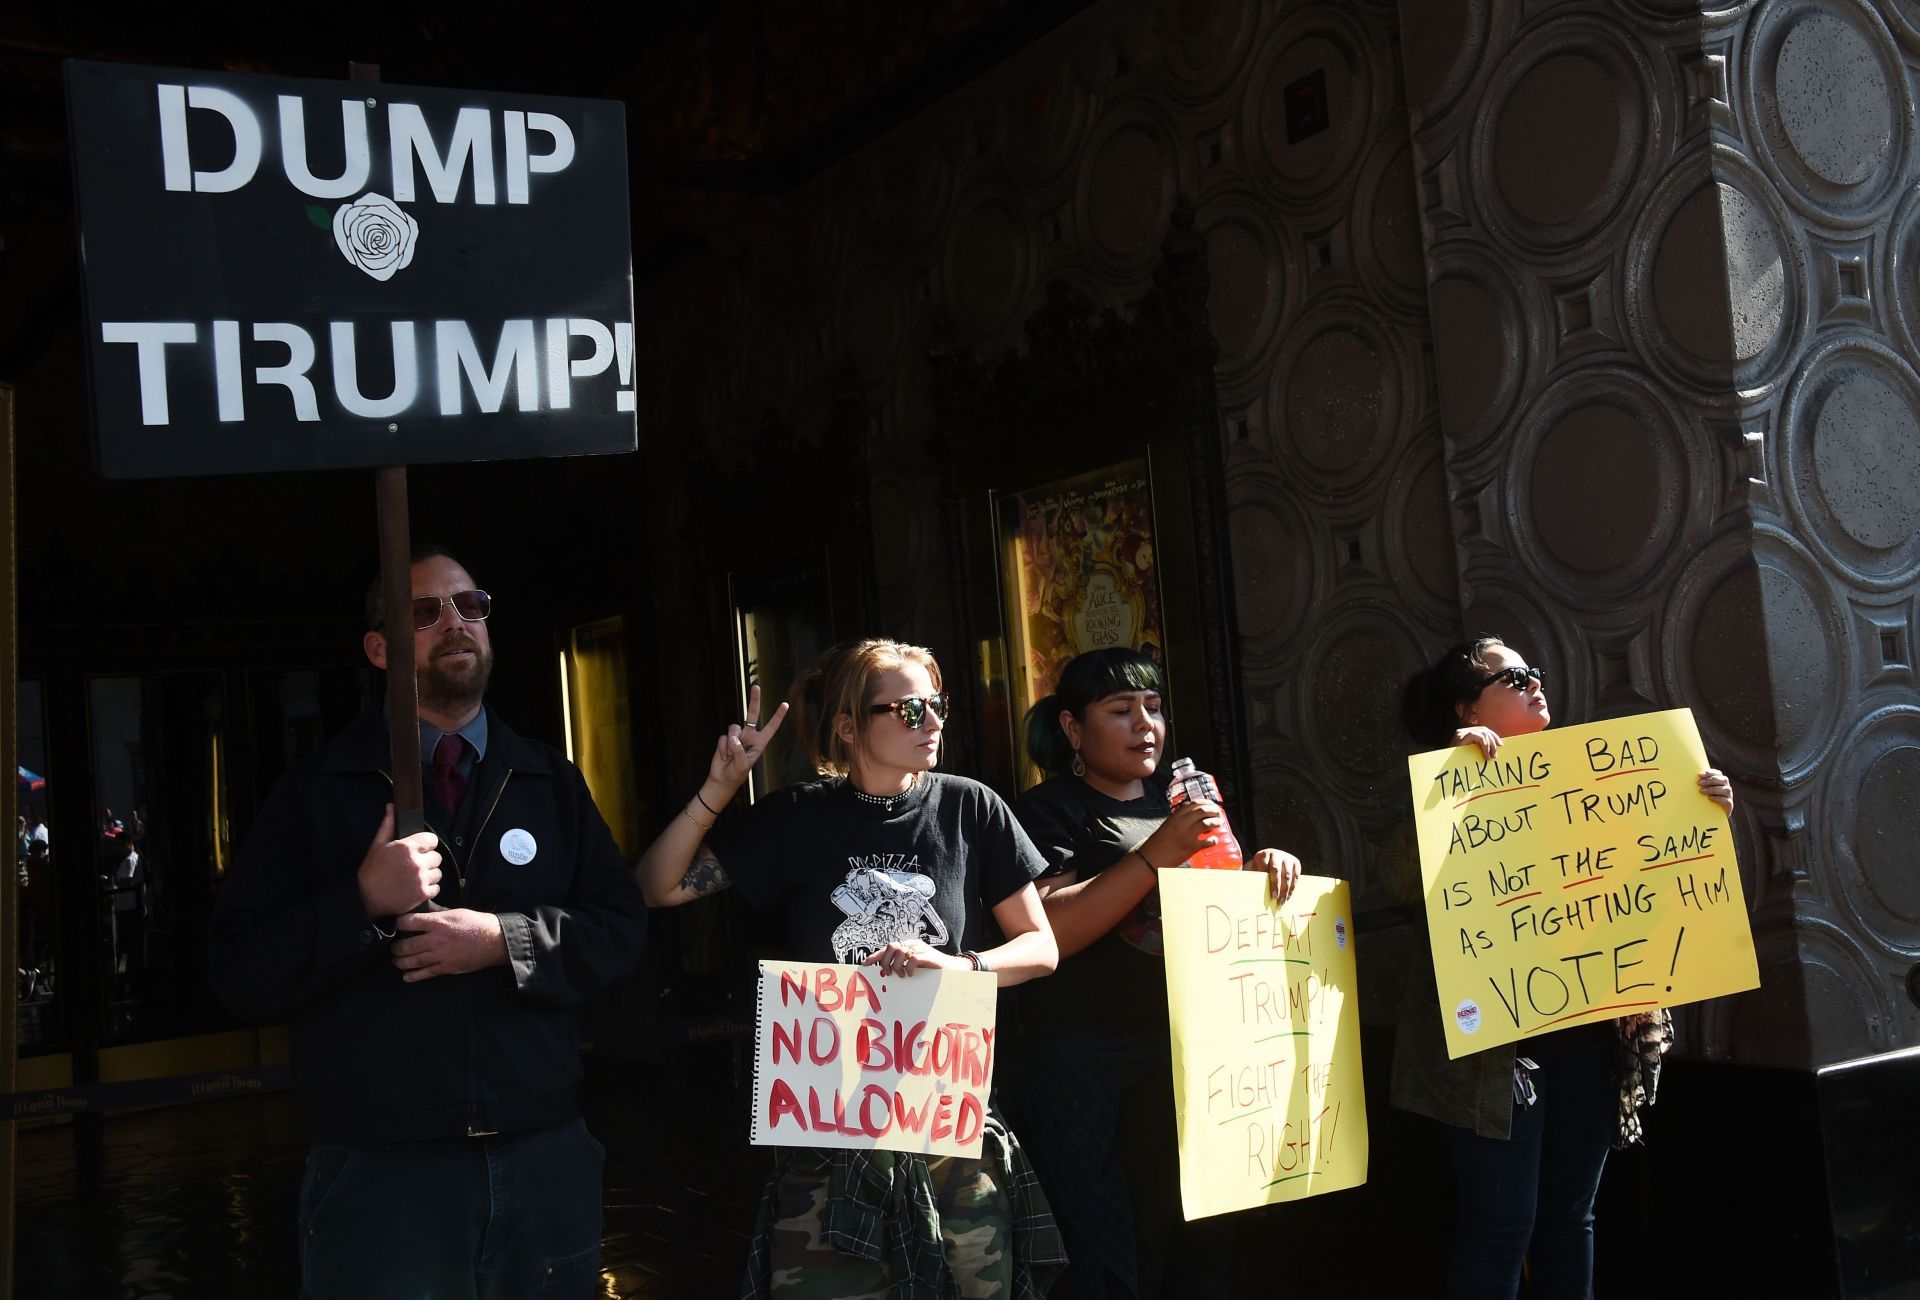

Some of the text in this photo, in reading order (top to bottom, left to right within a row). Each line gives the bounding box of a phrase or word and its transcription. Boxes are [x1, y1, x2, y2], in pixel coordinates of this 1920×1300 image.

[157, 83, 576, 205] DUMP
[101, 317, 636, 425] TRUMP!
[1088, 591, 1116, 609] ALICE
[1092, 629, 1119, 645] GLASS
[1434, 736, 1659, 800] TALKING BAD
[1449, 781, 1667, 855] ABOUT TRUMP
[1443, 826, 1719, 910] IS NOT THE SAME
[1206, 905, 1318, 956] DEFEAT
[1460, 867, 1730, 958] AS FIGHTING HIM
[780, 968, 888, 1014] NBA:
[1229, 968, 1328, 1025] TRUMP!
[1489, 926, 1686, 1029] VOTE!
[772, 1017, 996, 1088] NO BIGOTRY
[1208, 1059, 1335, 1113] FIGHT THE
[1247, 1101, 1342, 1178] RIGHT!
